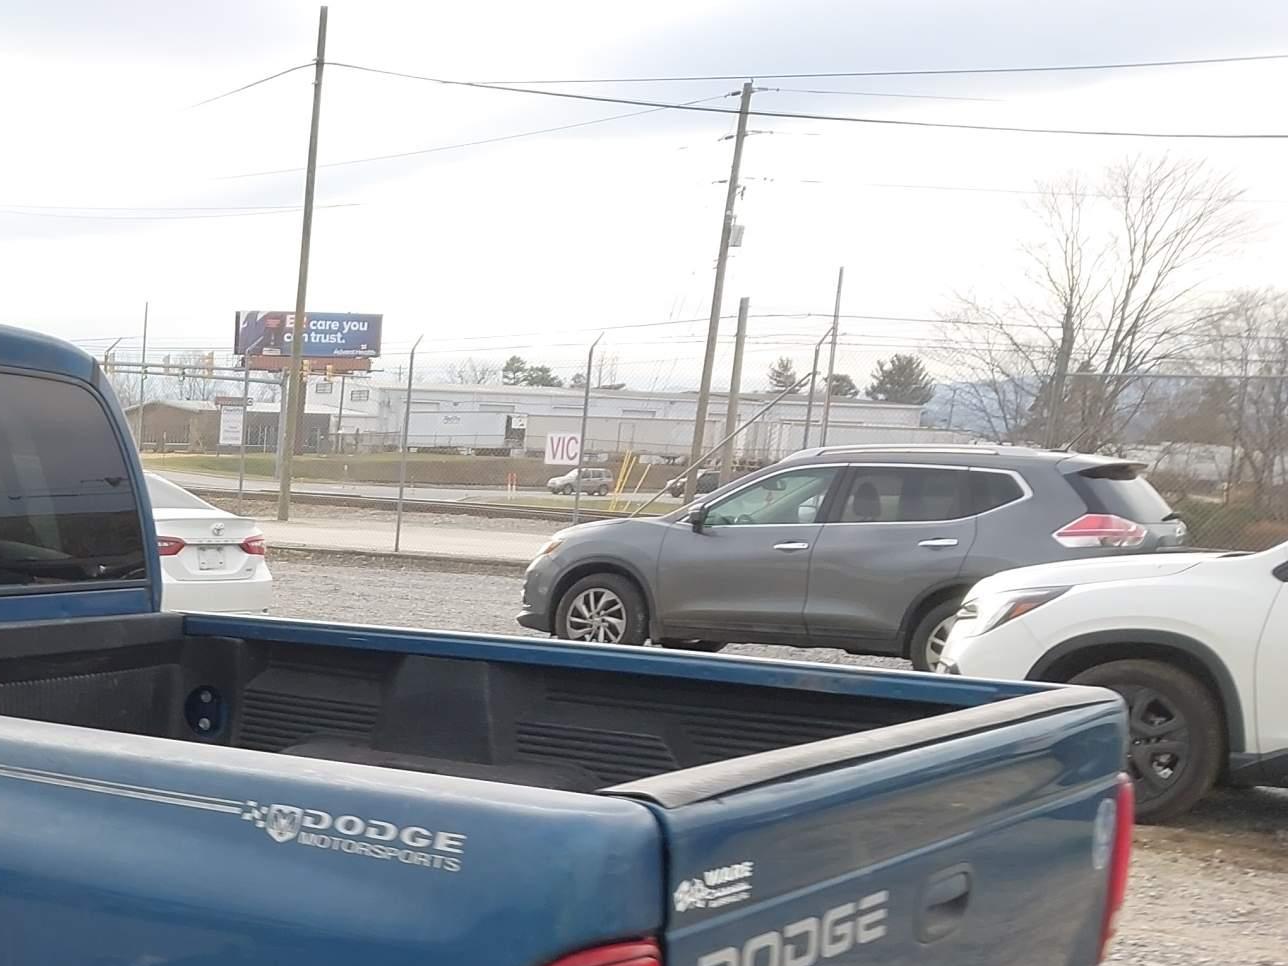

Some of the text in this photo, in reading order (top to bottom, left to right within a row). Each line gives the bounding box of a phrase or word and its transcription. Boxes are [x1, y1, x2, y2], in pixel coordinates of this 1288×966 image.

[283, 332, 346, 343] cn trust.
[309, 319, 339, 330] care
[343, 321, 368, 333] you
[550, 436, 579, 461] VIC
[302, 808, 468, 854] DODGE
[297, 831, 462, 872] MOTORSPORTS
